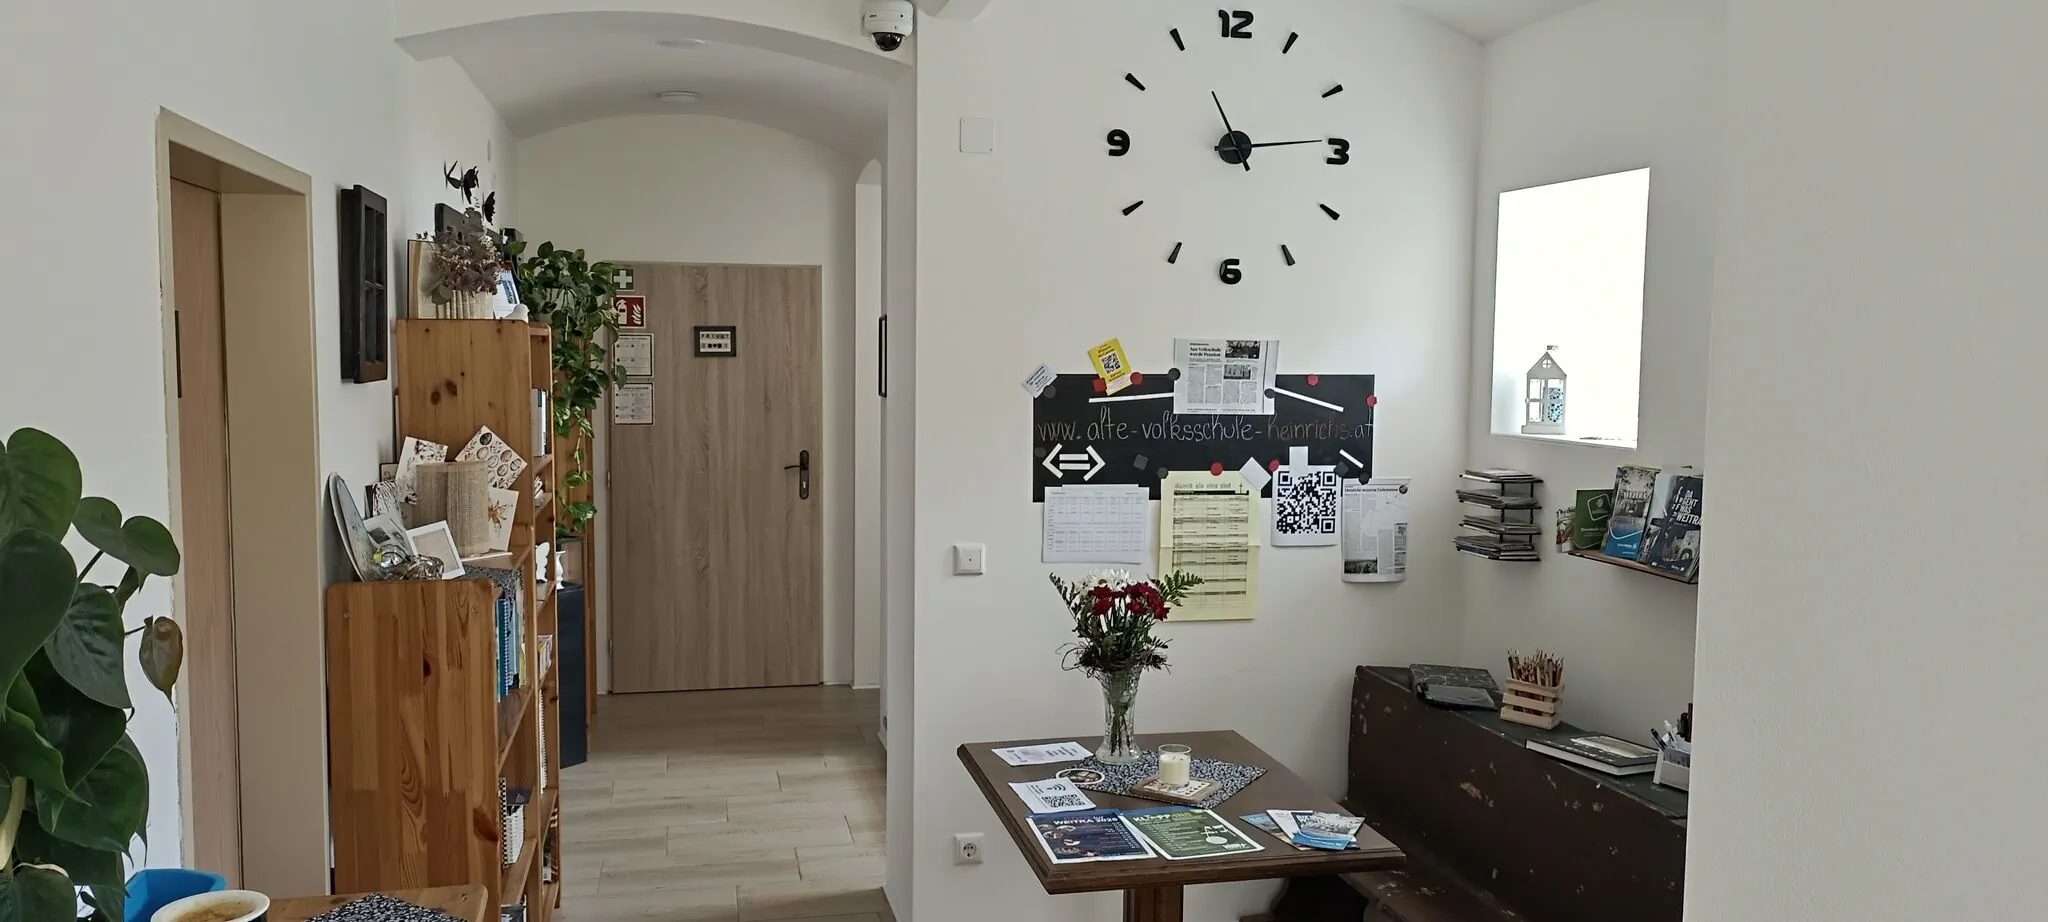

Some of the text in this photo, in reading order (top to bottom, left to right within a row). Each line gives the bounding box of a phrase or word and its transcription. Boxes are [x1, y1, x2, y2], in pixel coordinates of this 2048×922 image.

[1218, 9, 1254, 39] 12
[1106, 128, 1131, 157] 9
[1326, 137, 1350, 166] 3
[1218, 258, 1242, 285] 6
